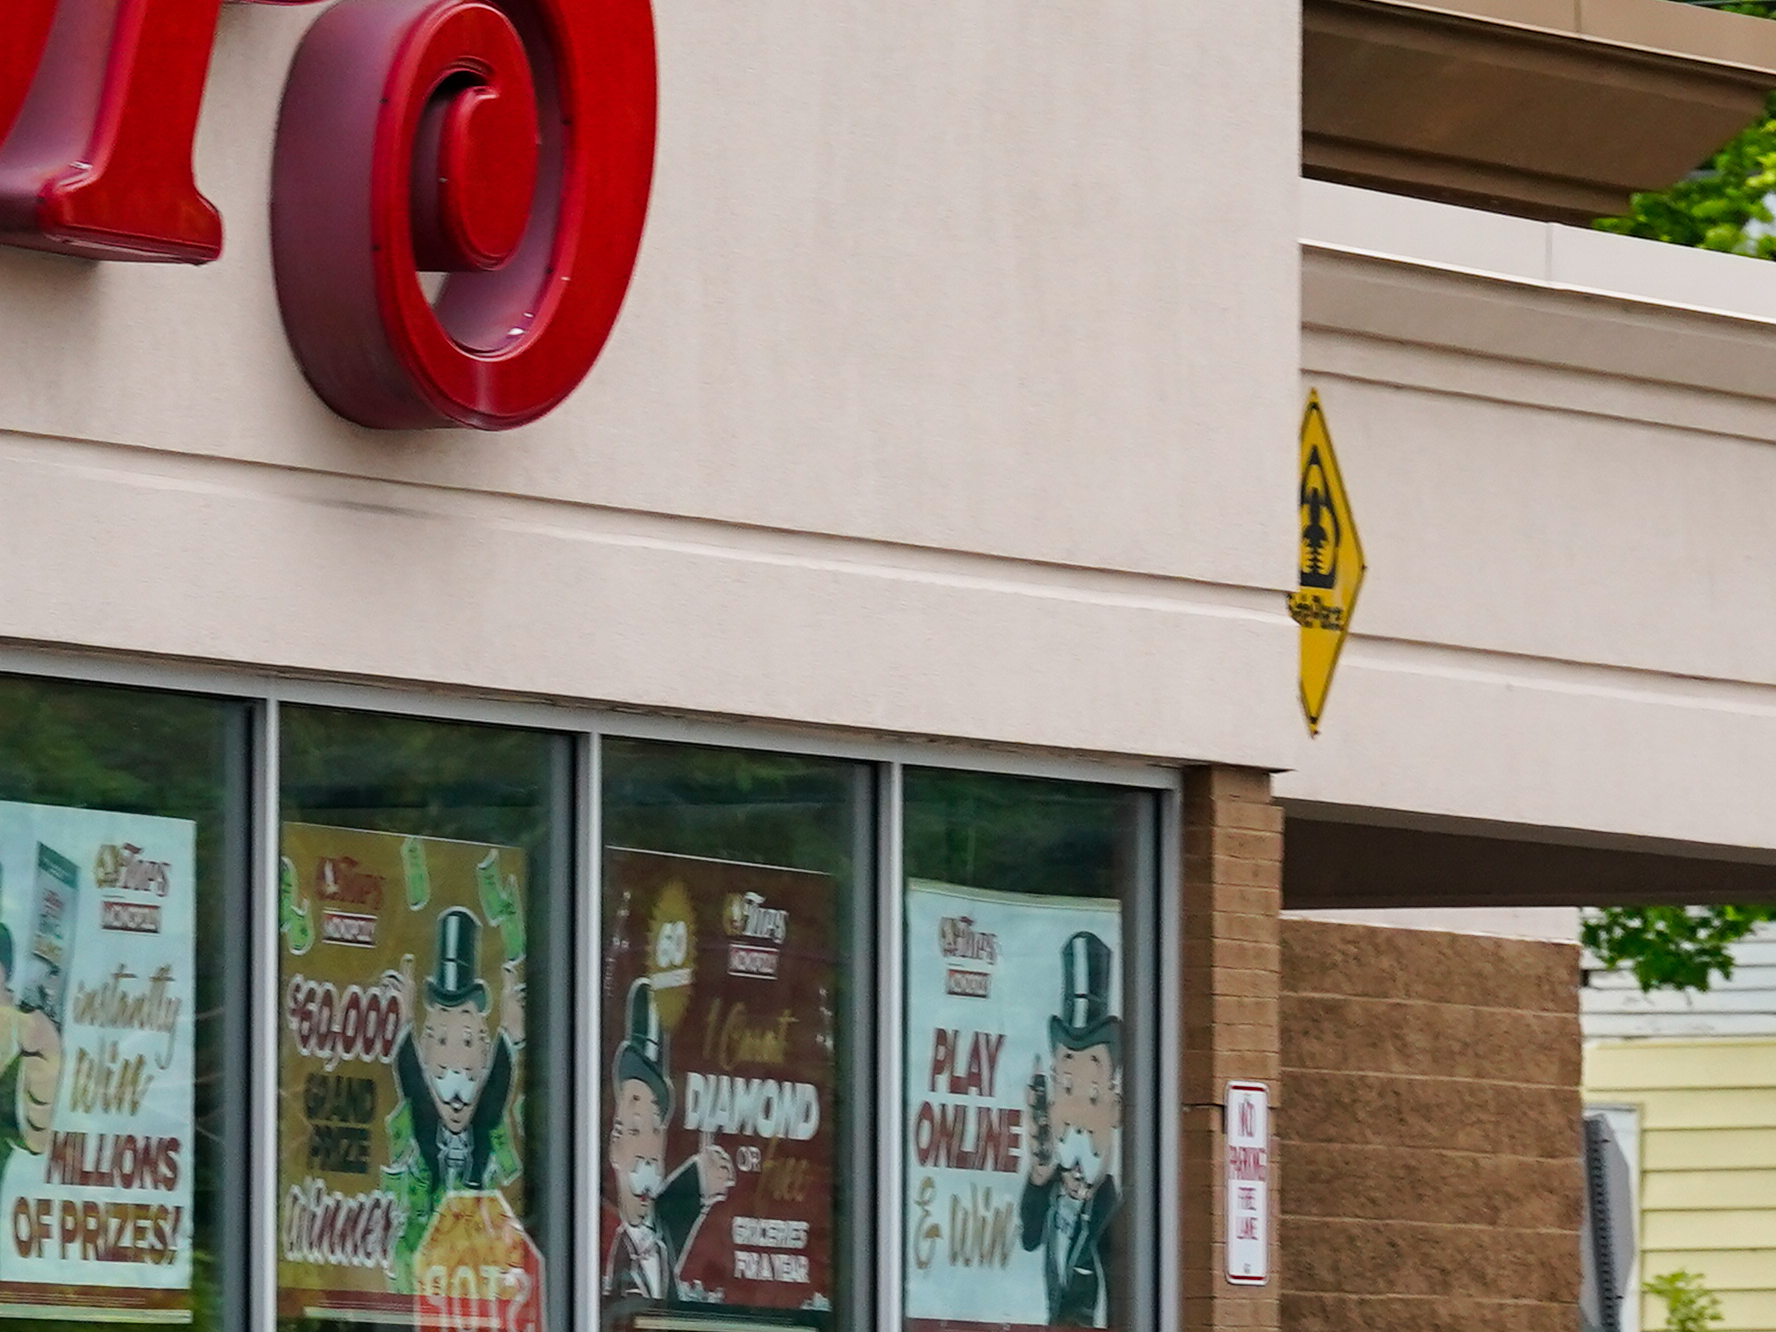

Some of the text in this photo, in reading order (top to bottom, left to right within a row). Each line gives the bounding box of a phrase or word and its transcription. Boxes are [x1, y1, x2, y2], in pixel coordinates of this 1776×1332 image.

[74, 964, 181, 1070] instantly
[930, 1028, 1007, 1097] PLAY
[684, 1072, 820, 1141] DIAMOND
[916, 1101, 1023, 1173] ONLINE
[1238, 1101, 1257, 1138] NO
[46, 1131, 180, 1191] MILLIONS
[736, 1146, 762, 1172] OR
[1229, 1146, 1266, 1182] PARKING
[14, 1196, 184, 1265] OF PRIZES!
